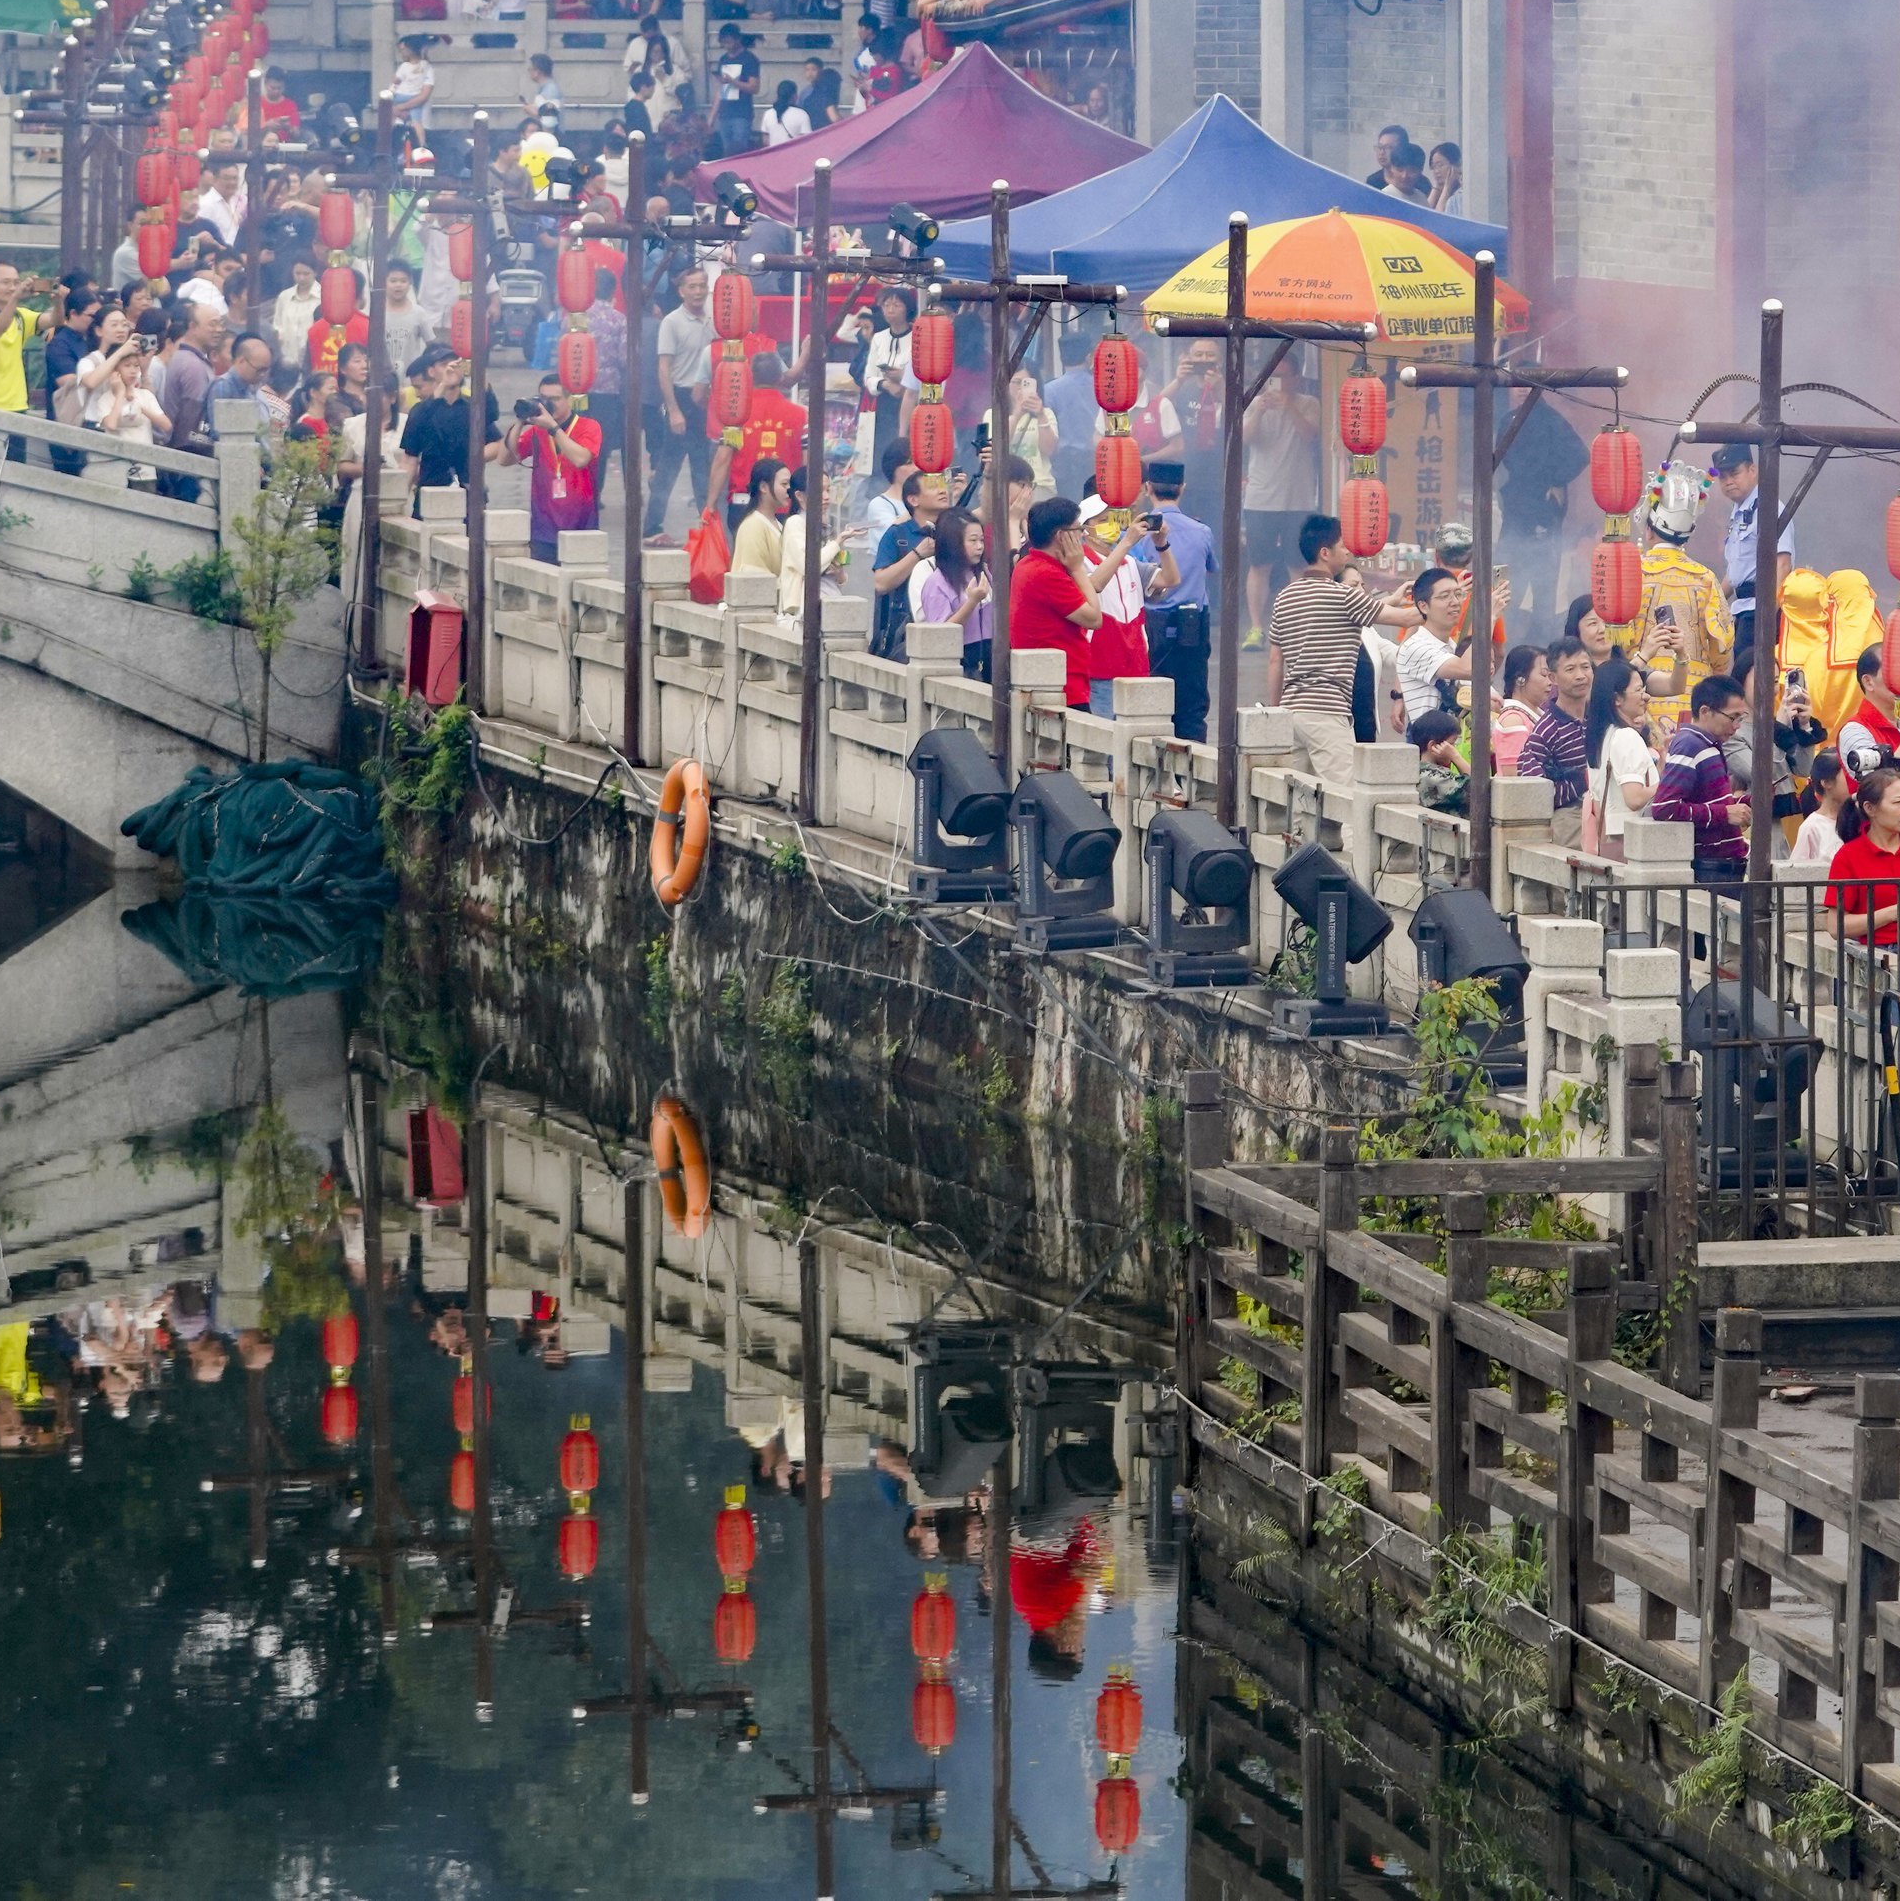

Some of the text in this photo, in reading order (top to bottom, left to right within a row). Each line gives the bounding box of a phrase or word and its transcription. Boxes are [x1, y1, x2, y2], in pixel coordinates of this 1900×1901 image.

[1278, 277, 1333, 289] 官方网站
[1252, 289, 1353, 300] www.zuche.com
[1379, 282, 1466, 300] 神州租车
